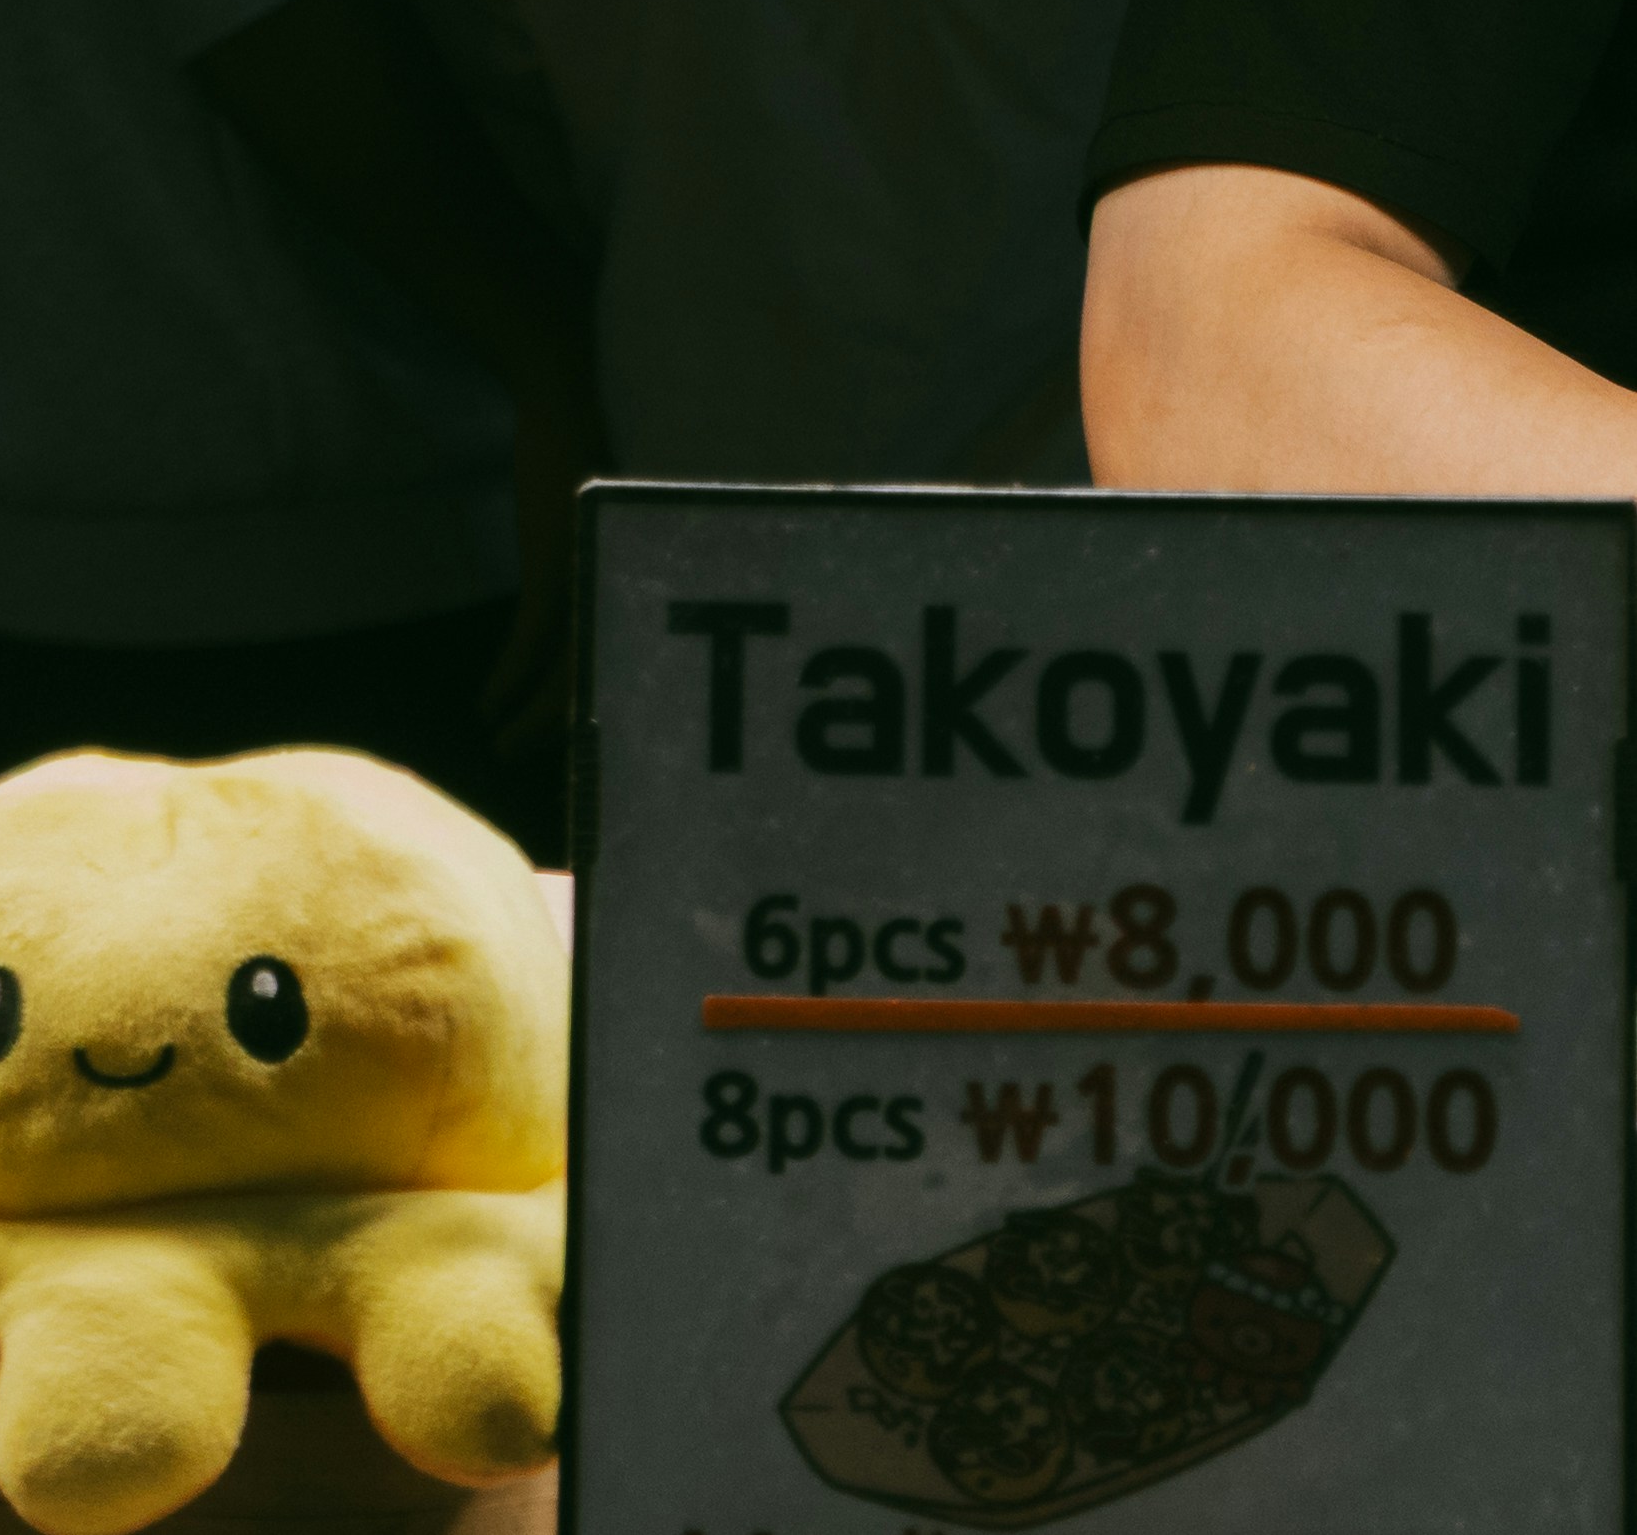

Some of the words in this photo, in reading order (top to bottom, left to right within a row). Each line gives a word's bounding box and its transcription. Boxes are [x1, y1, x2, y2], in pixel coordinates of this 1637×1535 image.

[667, 600, 1553, 826] Takoyaki
[742, 893, 968, 995] 6pcs
[1000, 883, 1461, 1004] ₩8,000
[698, 1069, 926, 1176] 8pcs
[960, 1063, 1499, 1186] ₩10,000
